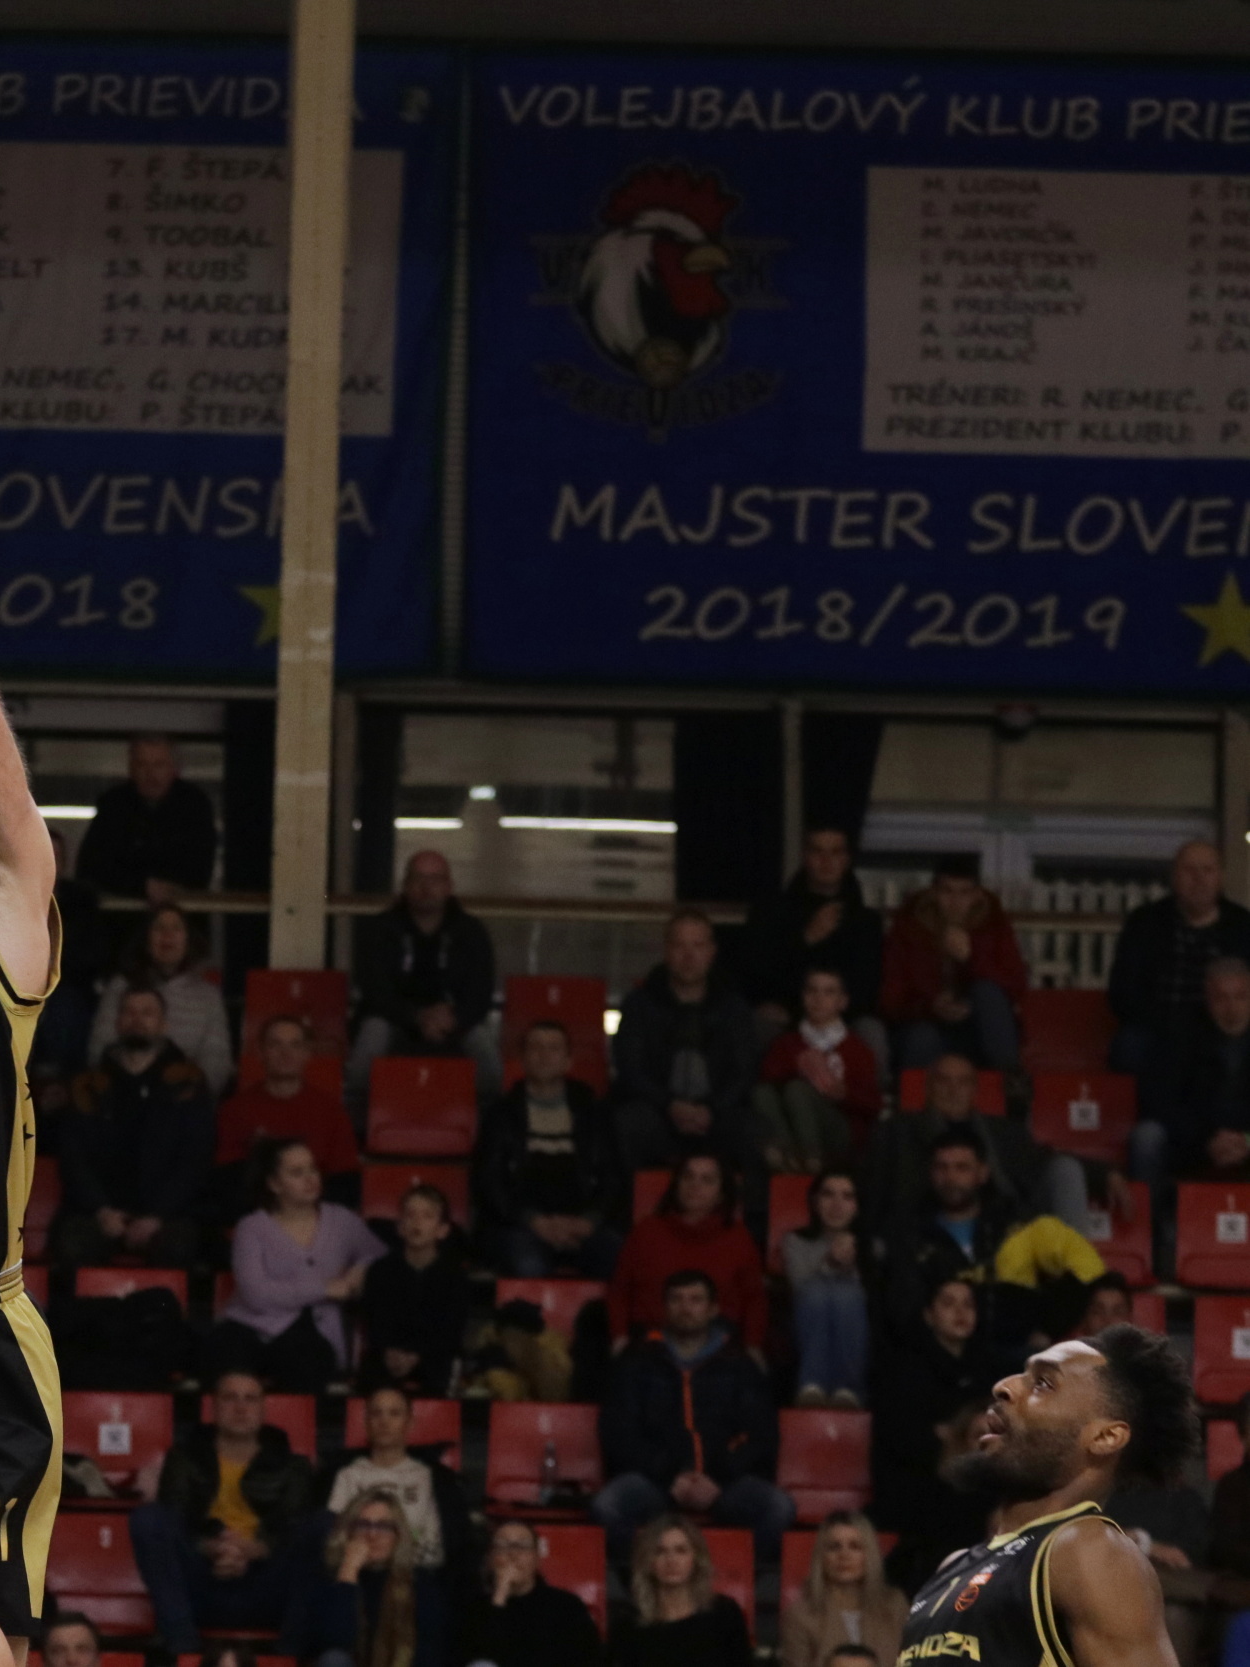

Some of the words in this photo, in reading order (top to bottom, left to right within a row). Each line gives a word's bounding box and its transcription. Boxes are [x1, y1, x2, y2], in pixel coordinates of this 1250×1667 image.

[53, 74, 365, 121] PRIEVID
[499, 75, 928, 135] VOLEJBALOVÝ
[947, 93, 1100, 142] KLUB
[181, 150, 288, 183] ŠTEPÁ
[550, 481, 935, 552] MAJSTER
[637, 581, 1129, 652] 2018/2019
